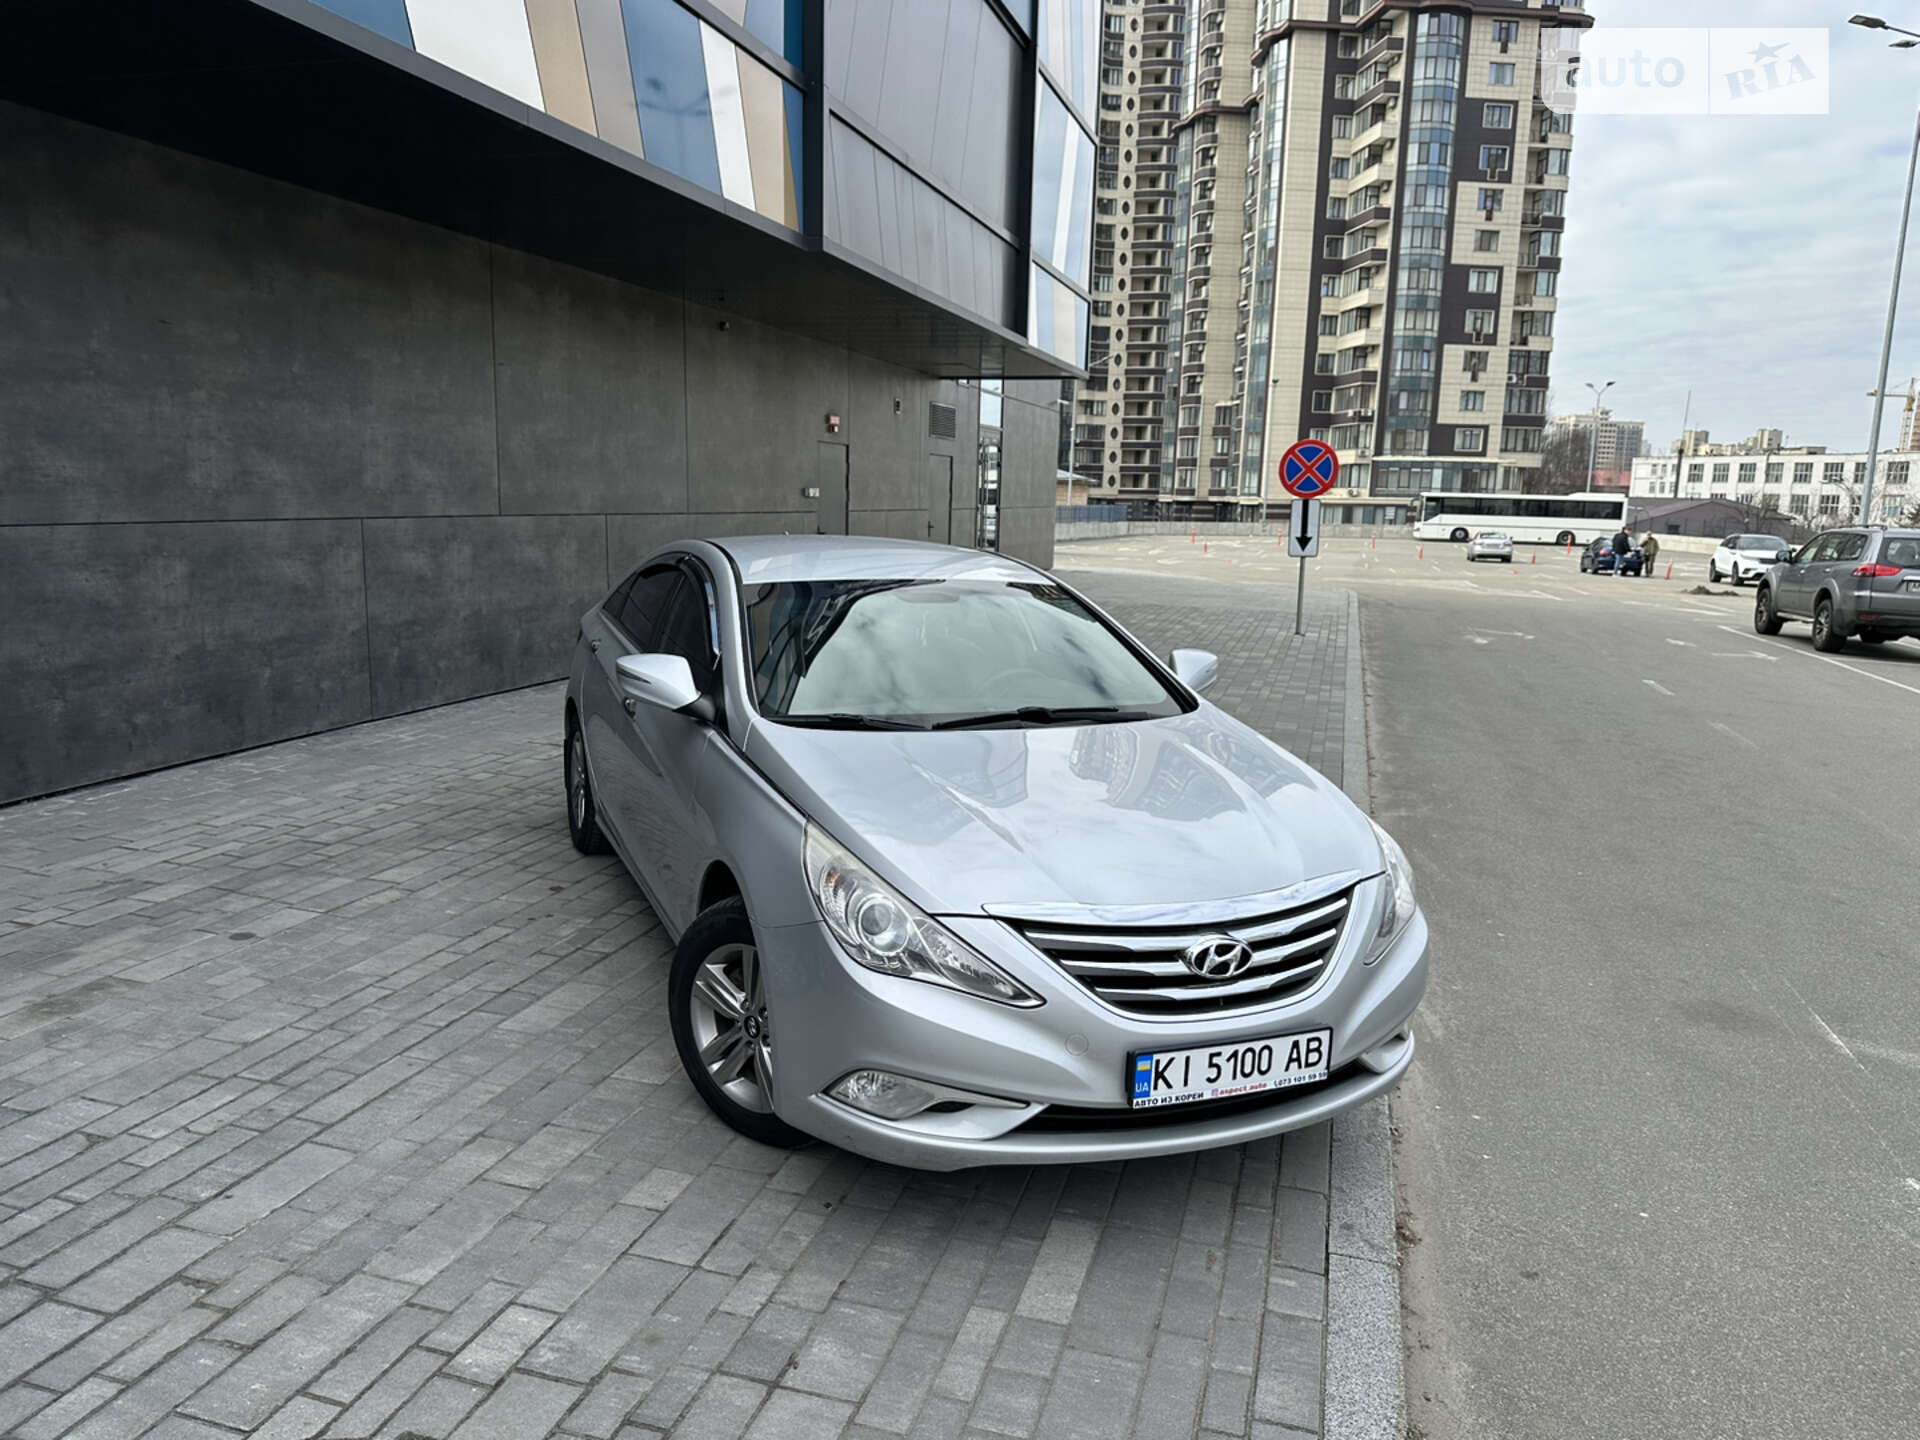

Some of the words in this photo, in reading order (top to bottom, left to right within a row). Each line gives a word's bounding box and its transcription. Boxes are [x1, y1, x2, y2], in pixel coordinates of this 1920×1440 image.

[1153, 1056, 1190, 1090] KI
[1206, 1045, 1273, 1084] 5100
[1284, 1036, 1323, 1072] AB
[1136, 1082, 1149, 1092] UA
[1135, 1097, 1158, 1107] АВТО
